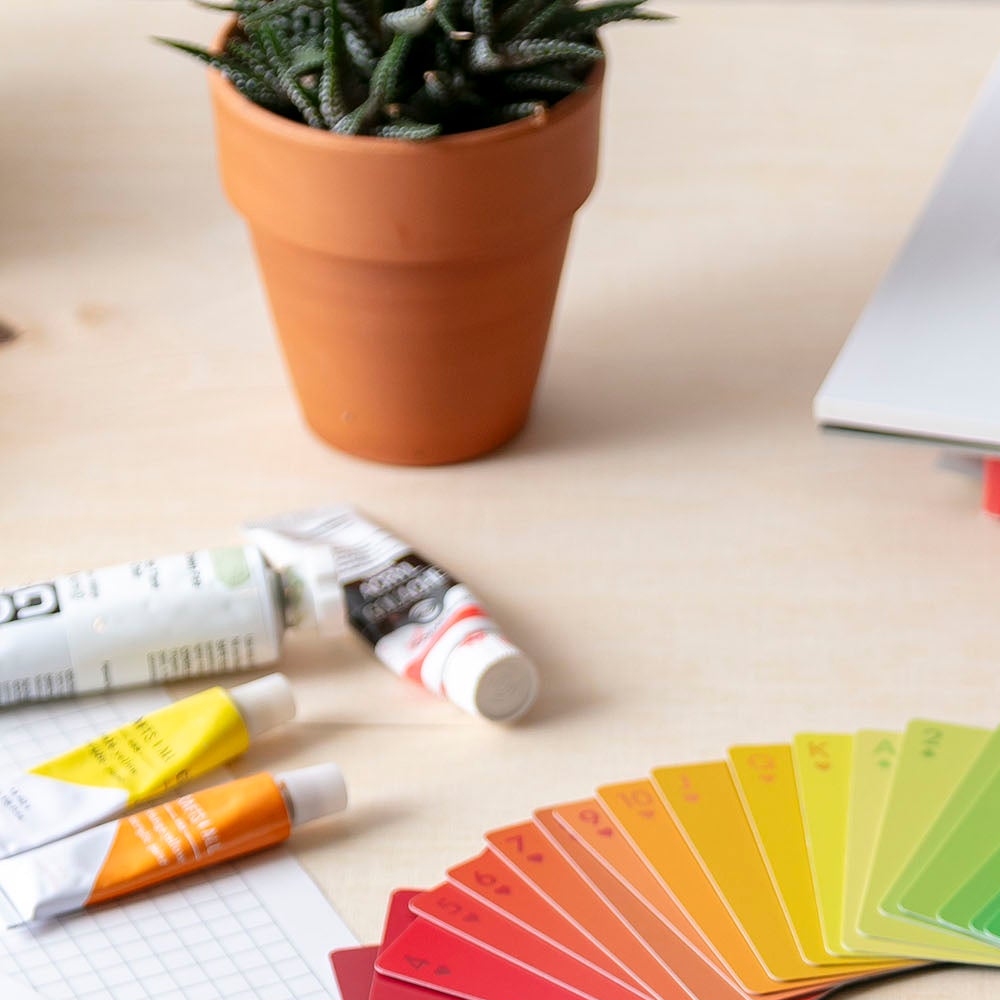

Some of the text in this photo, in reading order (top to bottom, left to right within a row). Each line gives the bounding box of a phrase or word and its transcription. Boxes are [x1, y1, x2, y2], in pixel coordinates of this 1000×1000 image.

[923, 728, 943, 745] 2
[808, 741, 829, 757] K
[874, 738, 895, 754] A
[748, 752, 775, 770] Q
[616, 789, 655, 808] 10
[578, 809, 599, 825] 9
[505, 834, 524, 852] 7
[475, 870, 496, 887] 6
[438, 899, 462, 915] 5
[404, 955, 429, 970] 4
